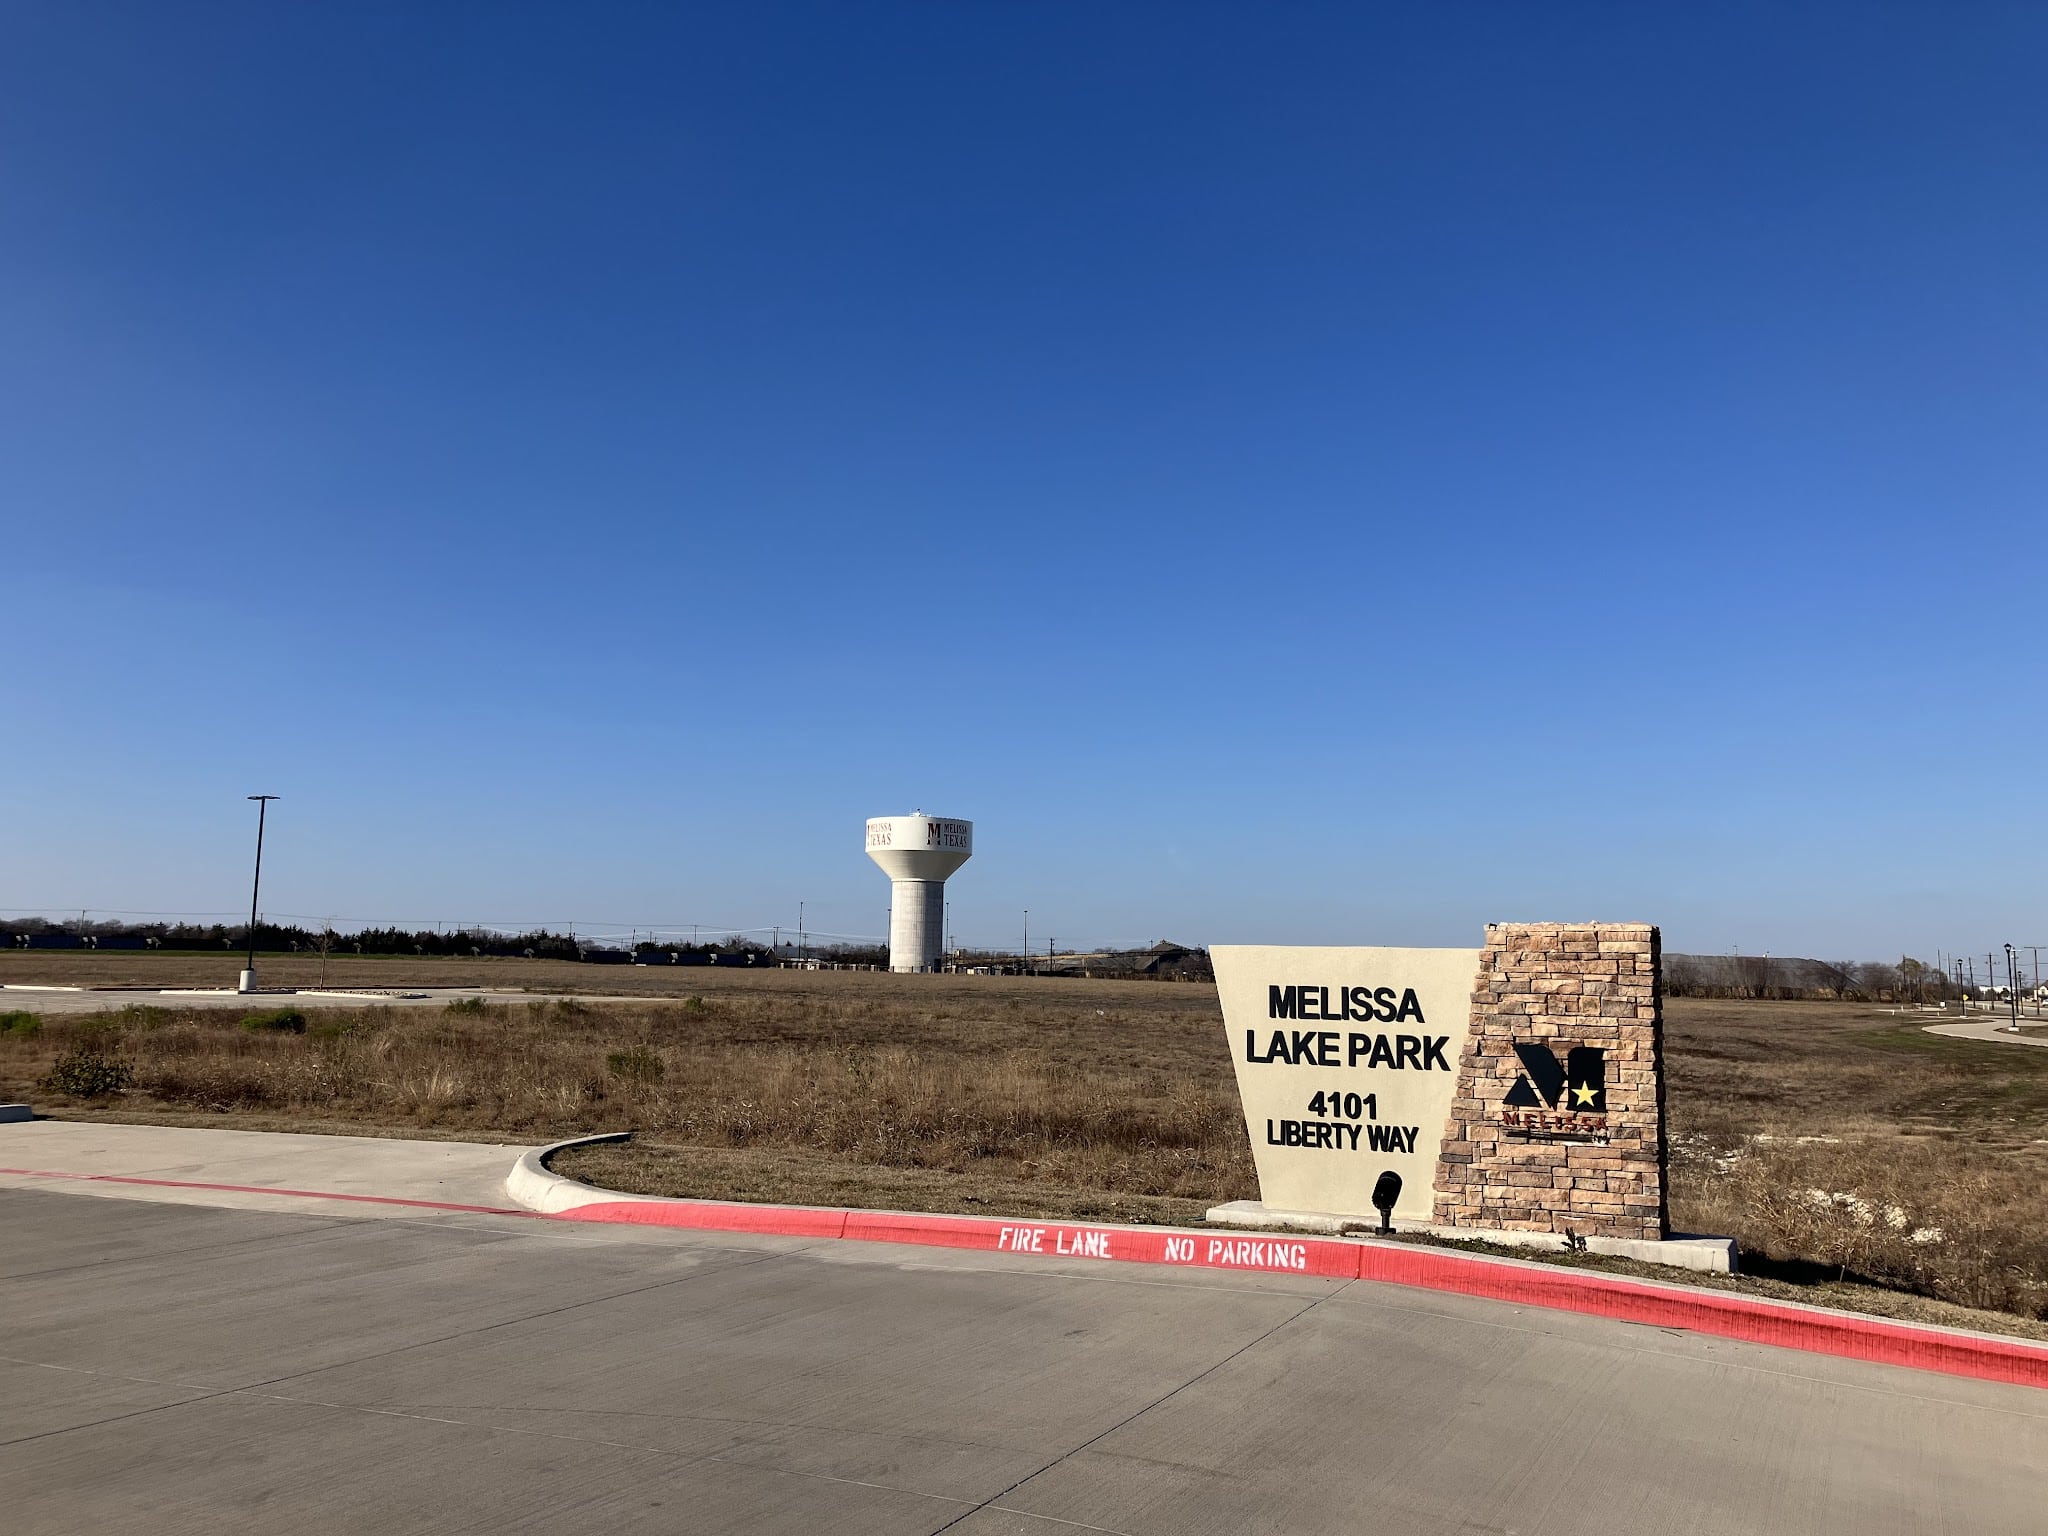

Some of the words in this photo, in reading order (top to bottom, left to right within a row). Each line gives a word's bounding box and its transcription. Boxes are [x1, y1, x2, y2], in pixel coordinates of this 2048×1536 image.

[870, 832, 892, 846] TEXAS
[944, 823, 968, 834] MELISSA
[944, 833, 967, 848] TEXAS
[1269, 985, 1425, 1023] MELISSA
[1246, 1029, 1341, 1067] LAKE
[1348, 1032, 1451, 1071] PARK
[1307, 1090, 1377, 1120] 4101
[1267, 1119, 1362, 1150] LIBERTY
[1367, 1124, 1420, 1153] WAY
[1502, 1111, 1609, 1132] MELISSA
[998, 1227, 1045, 1252] FIRE
[1056, 1230, 1112, 1259] LANE
[1164, 1237, 1195, 1262] NO
[1207, 1240, 1306, 1269] PARKING
